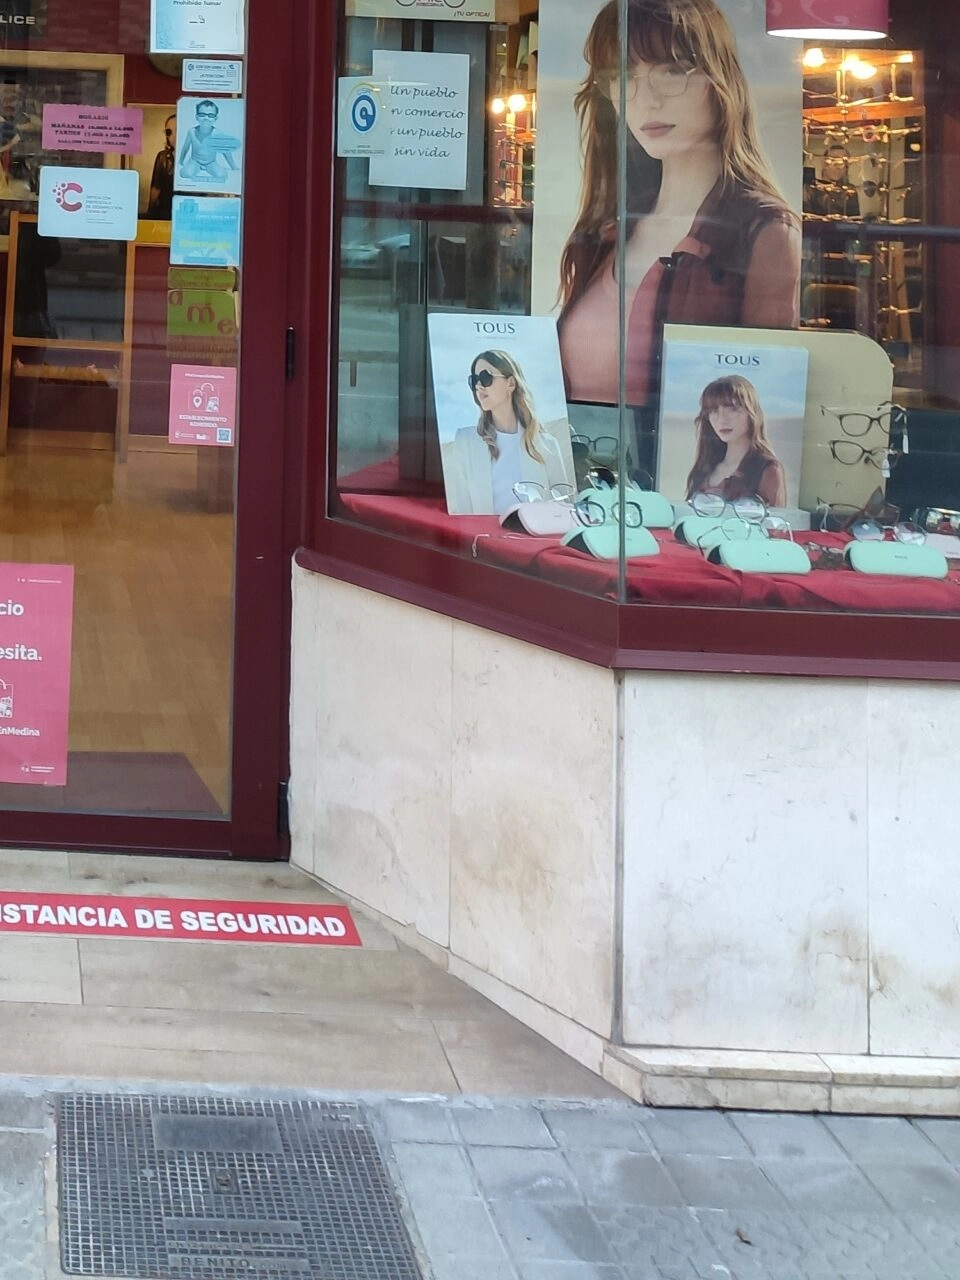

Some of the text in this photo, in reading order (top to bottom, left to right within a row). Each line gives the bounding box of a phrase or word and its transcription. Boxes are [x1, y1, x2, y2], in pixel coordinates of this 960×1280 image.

[412, 86, 459, 100] pueblo
[404, 108, 466, 119] comercio
[418, 127, 465, 141] pueblo
[393, 147, 450, 158] sin vida
[474, 321, 515, 335] TOUS
[715, 353, 761, 367] TOUS
[135, 908, 174, 931] DE
[180, 910, 347, 938] SEGURIDAD
[180, 1256, 251, 1268] BENITO
